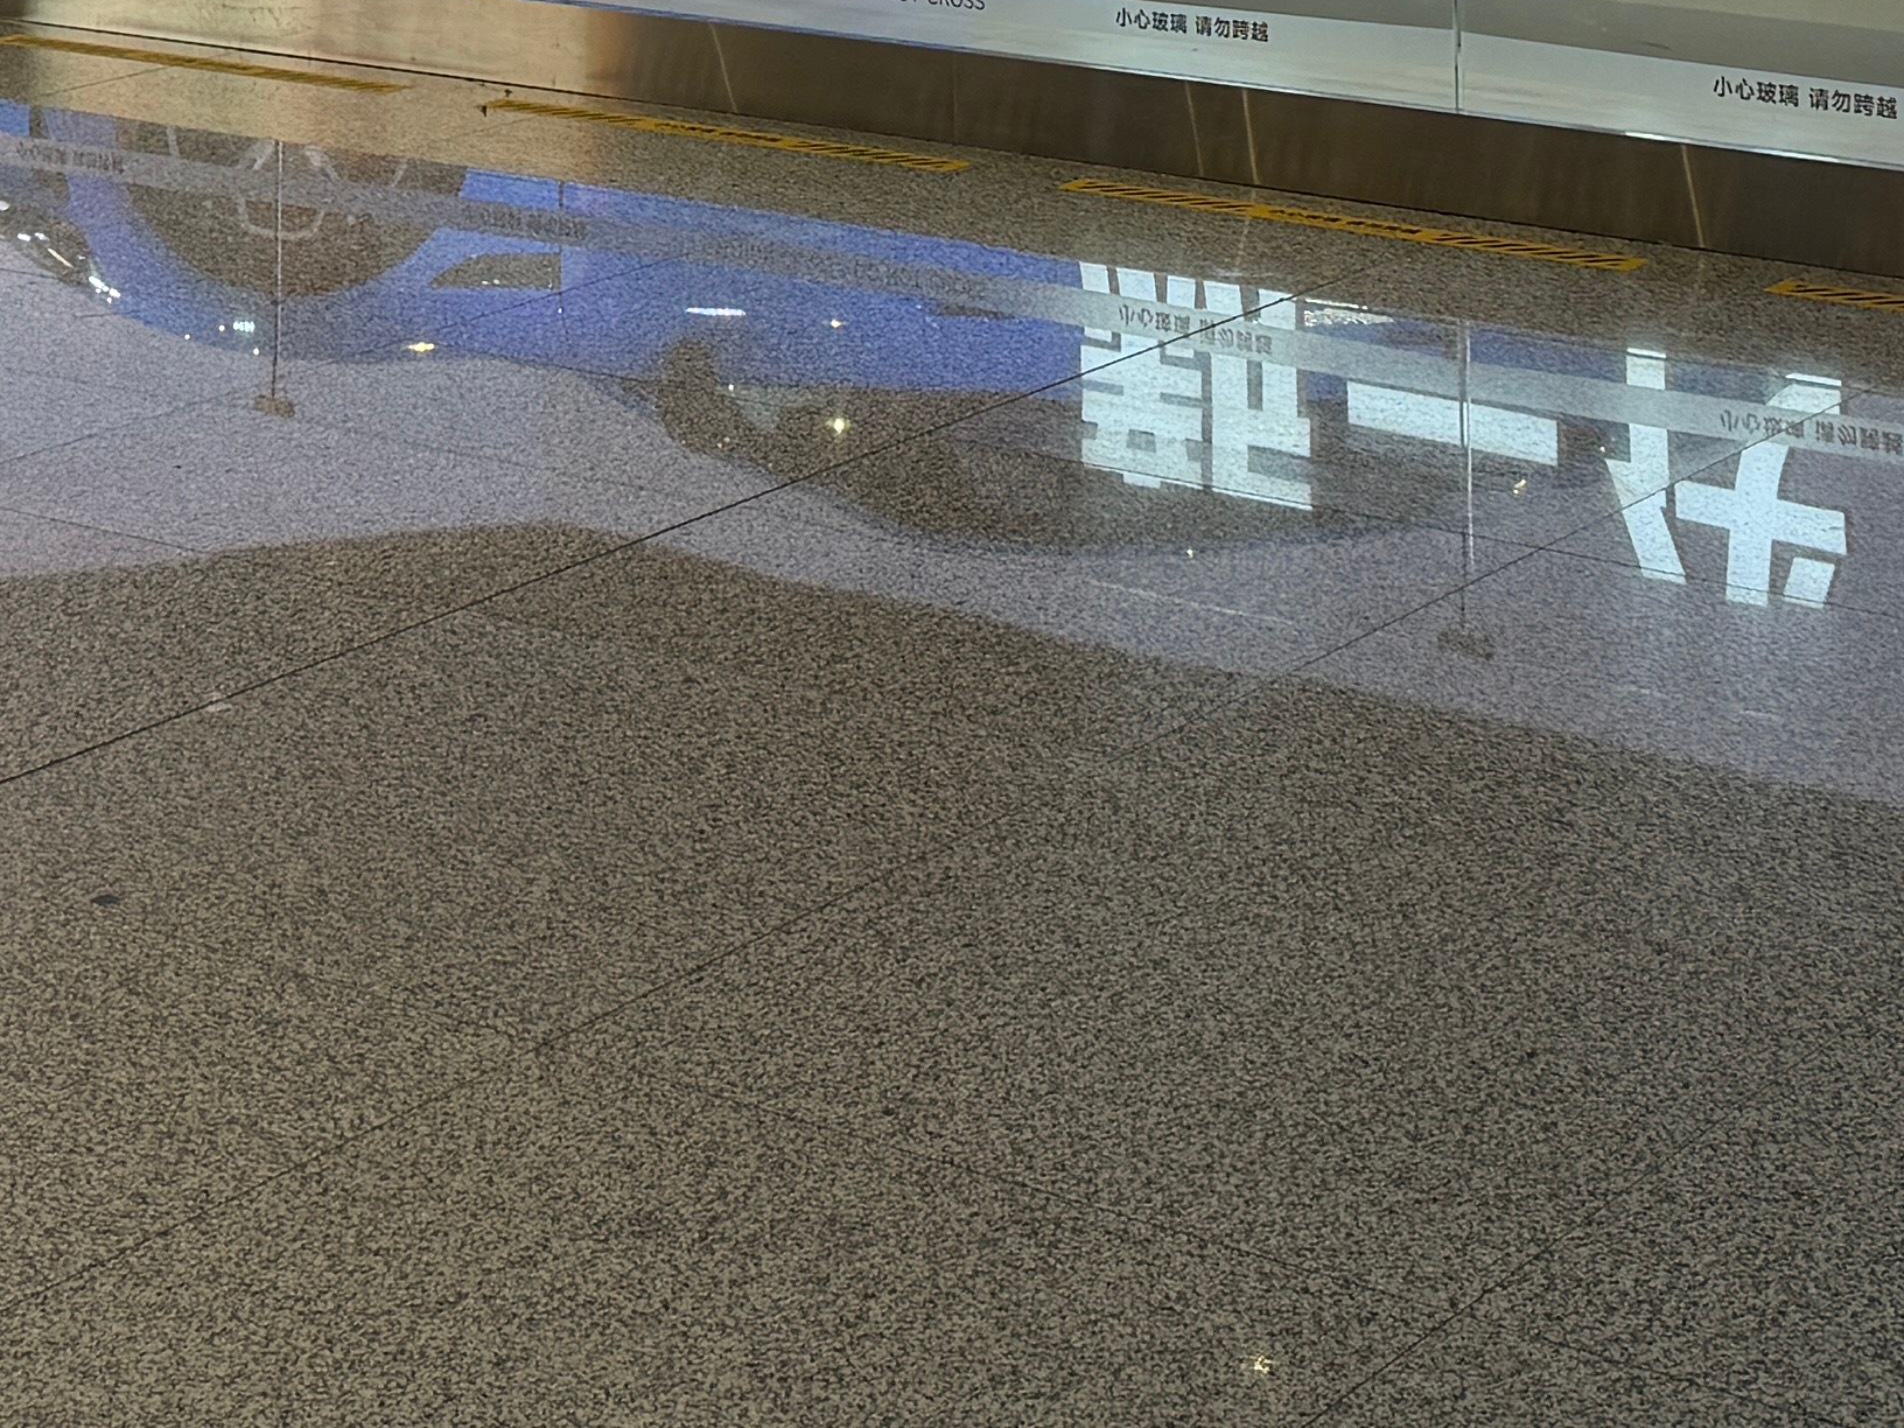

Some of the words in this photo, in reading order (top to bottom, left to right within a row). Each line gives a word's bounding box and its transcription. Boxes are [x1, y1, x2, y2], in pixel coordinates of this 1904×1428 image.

[1115, 6, 1188, 36] 小心玻璃
[1194, 13, 1269, 44] 请勿跨越
[1712, 74, 1800, 109] 小心玻璃
[1808, 86, 1899, 121] 请勿跨越
